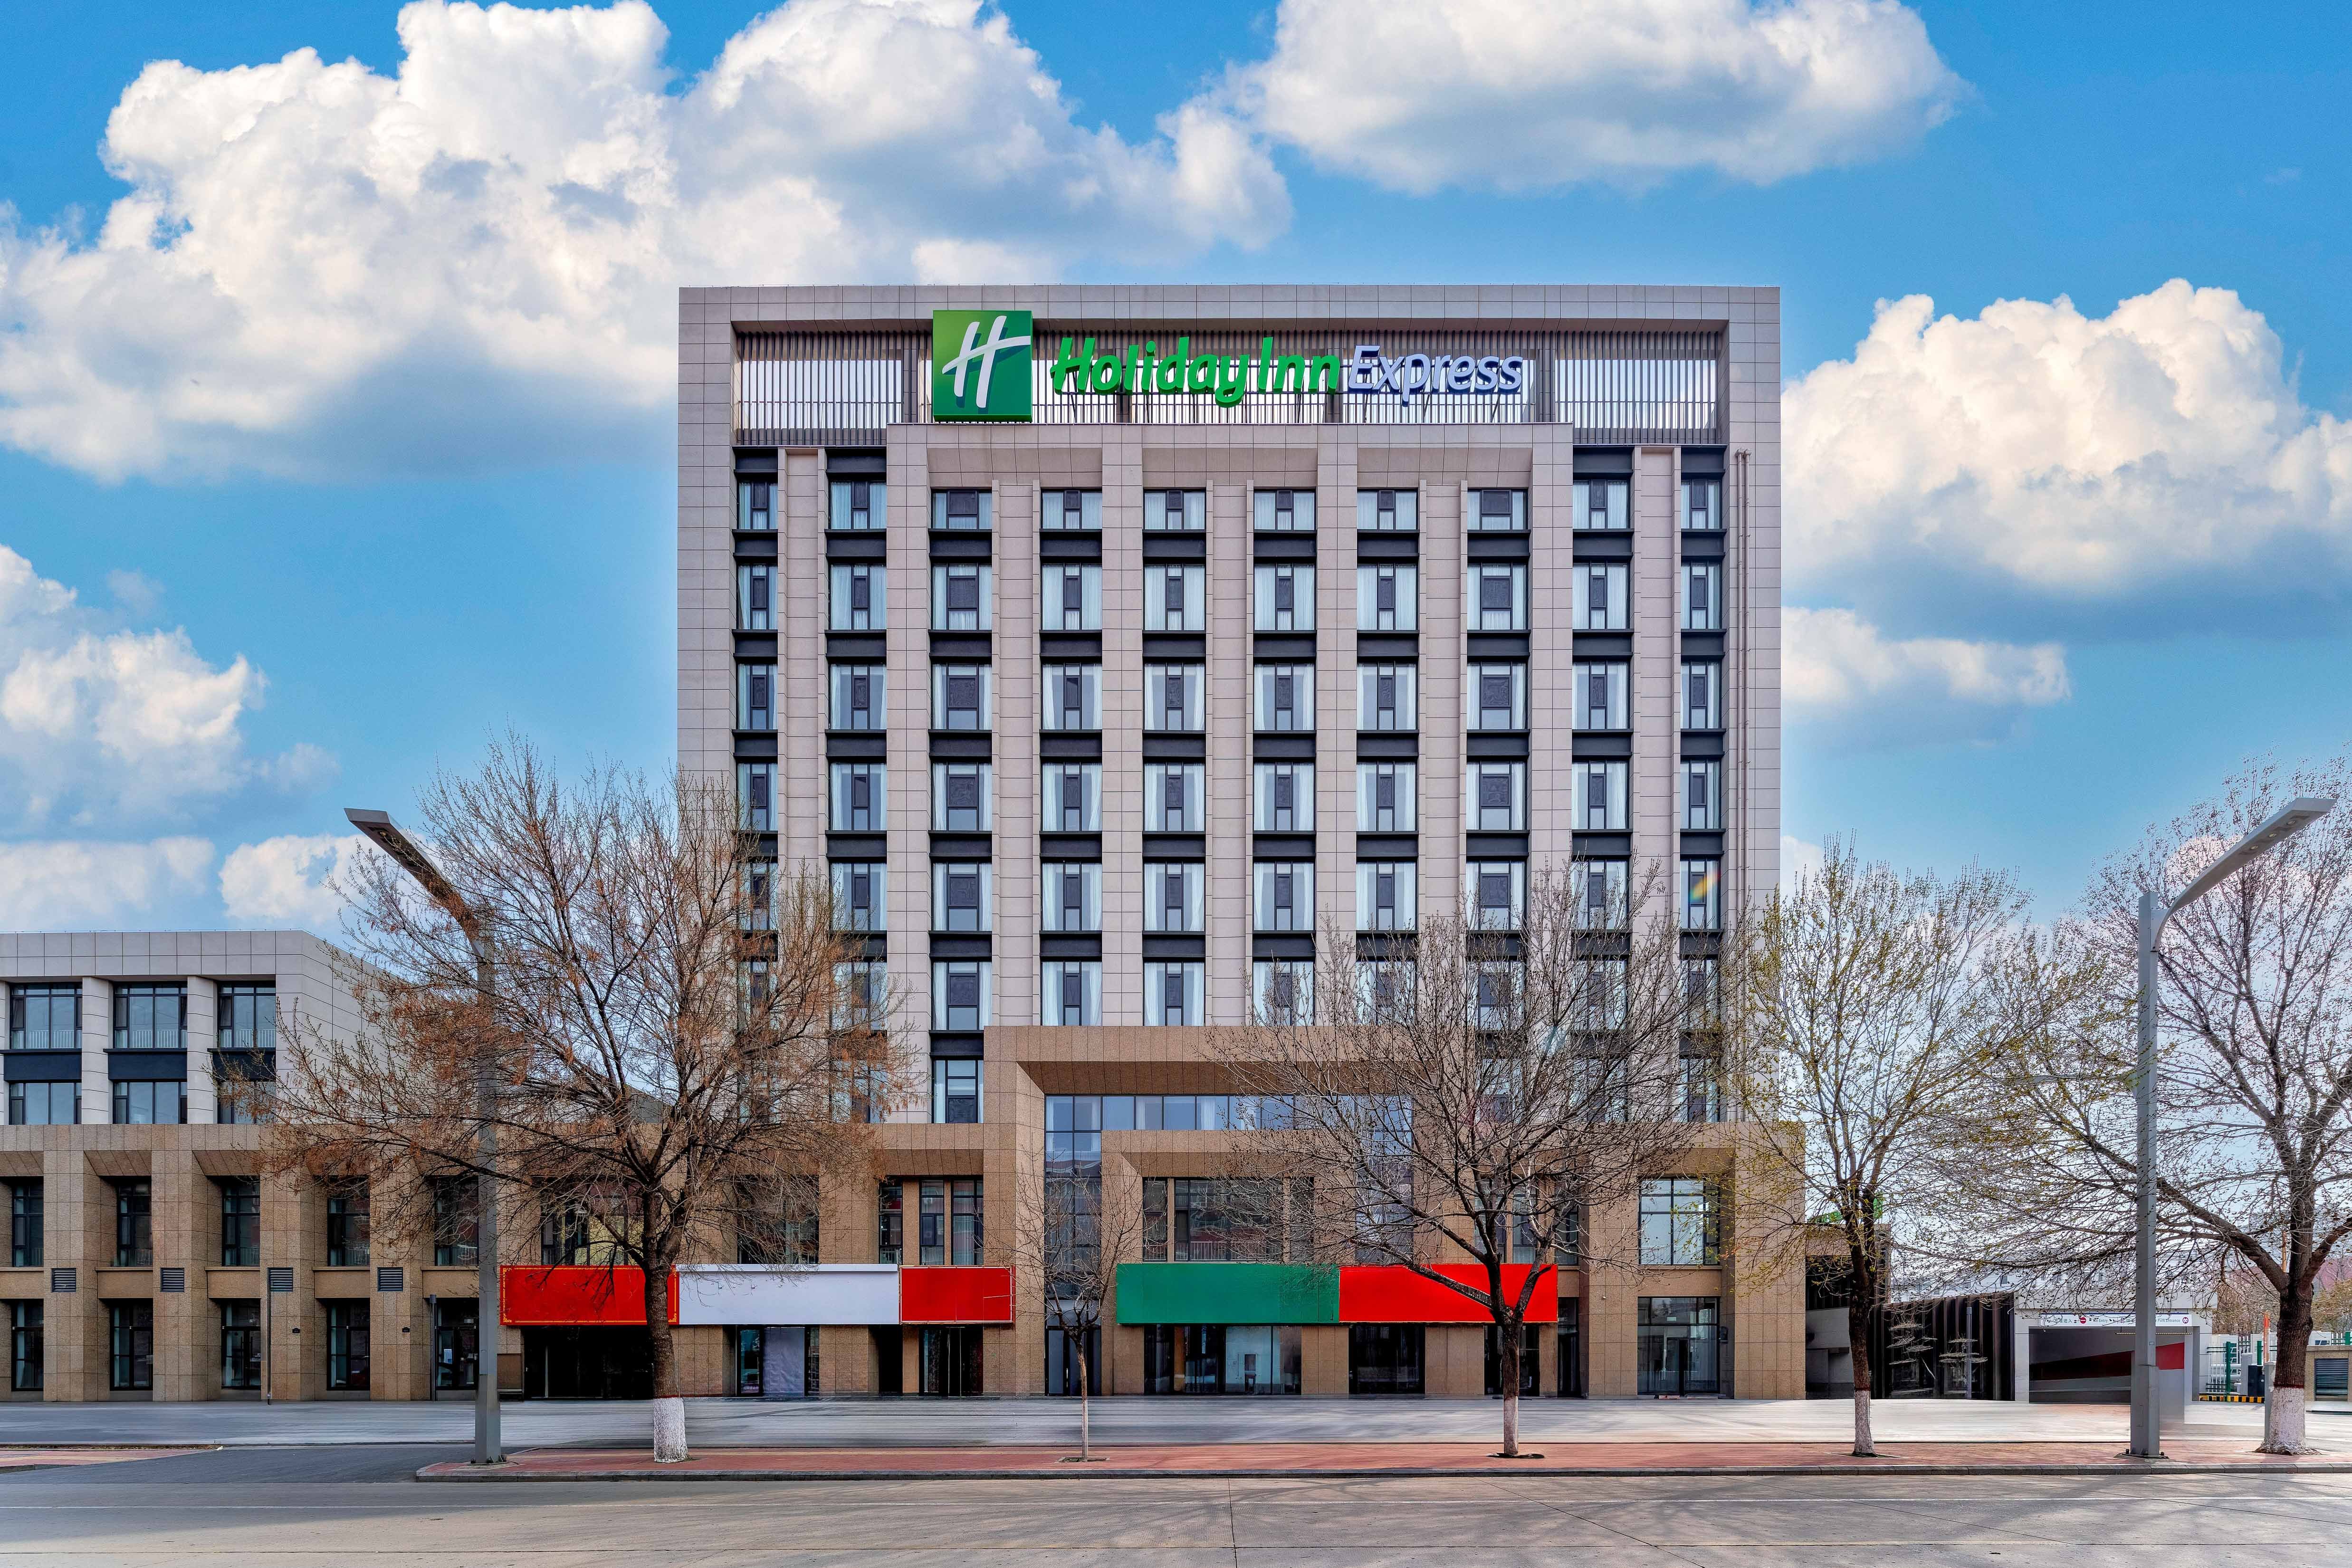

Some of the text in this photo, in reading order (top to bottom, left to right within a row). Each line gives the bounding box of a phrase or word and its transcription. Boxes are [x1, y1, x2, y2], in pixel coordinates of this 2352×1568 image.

[1050, 337, 1523, 407] Holiday Inn Express
